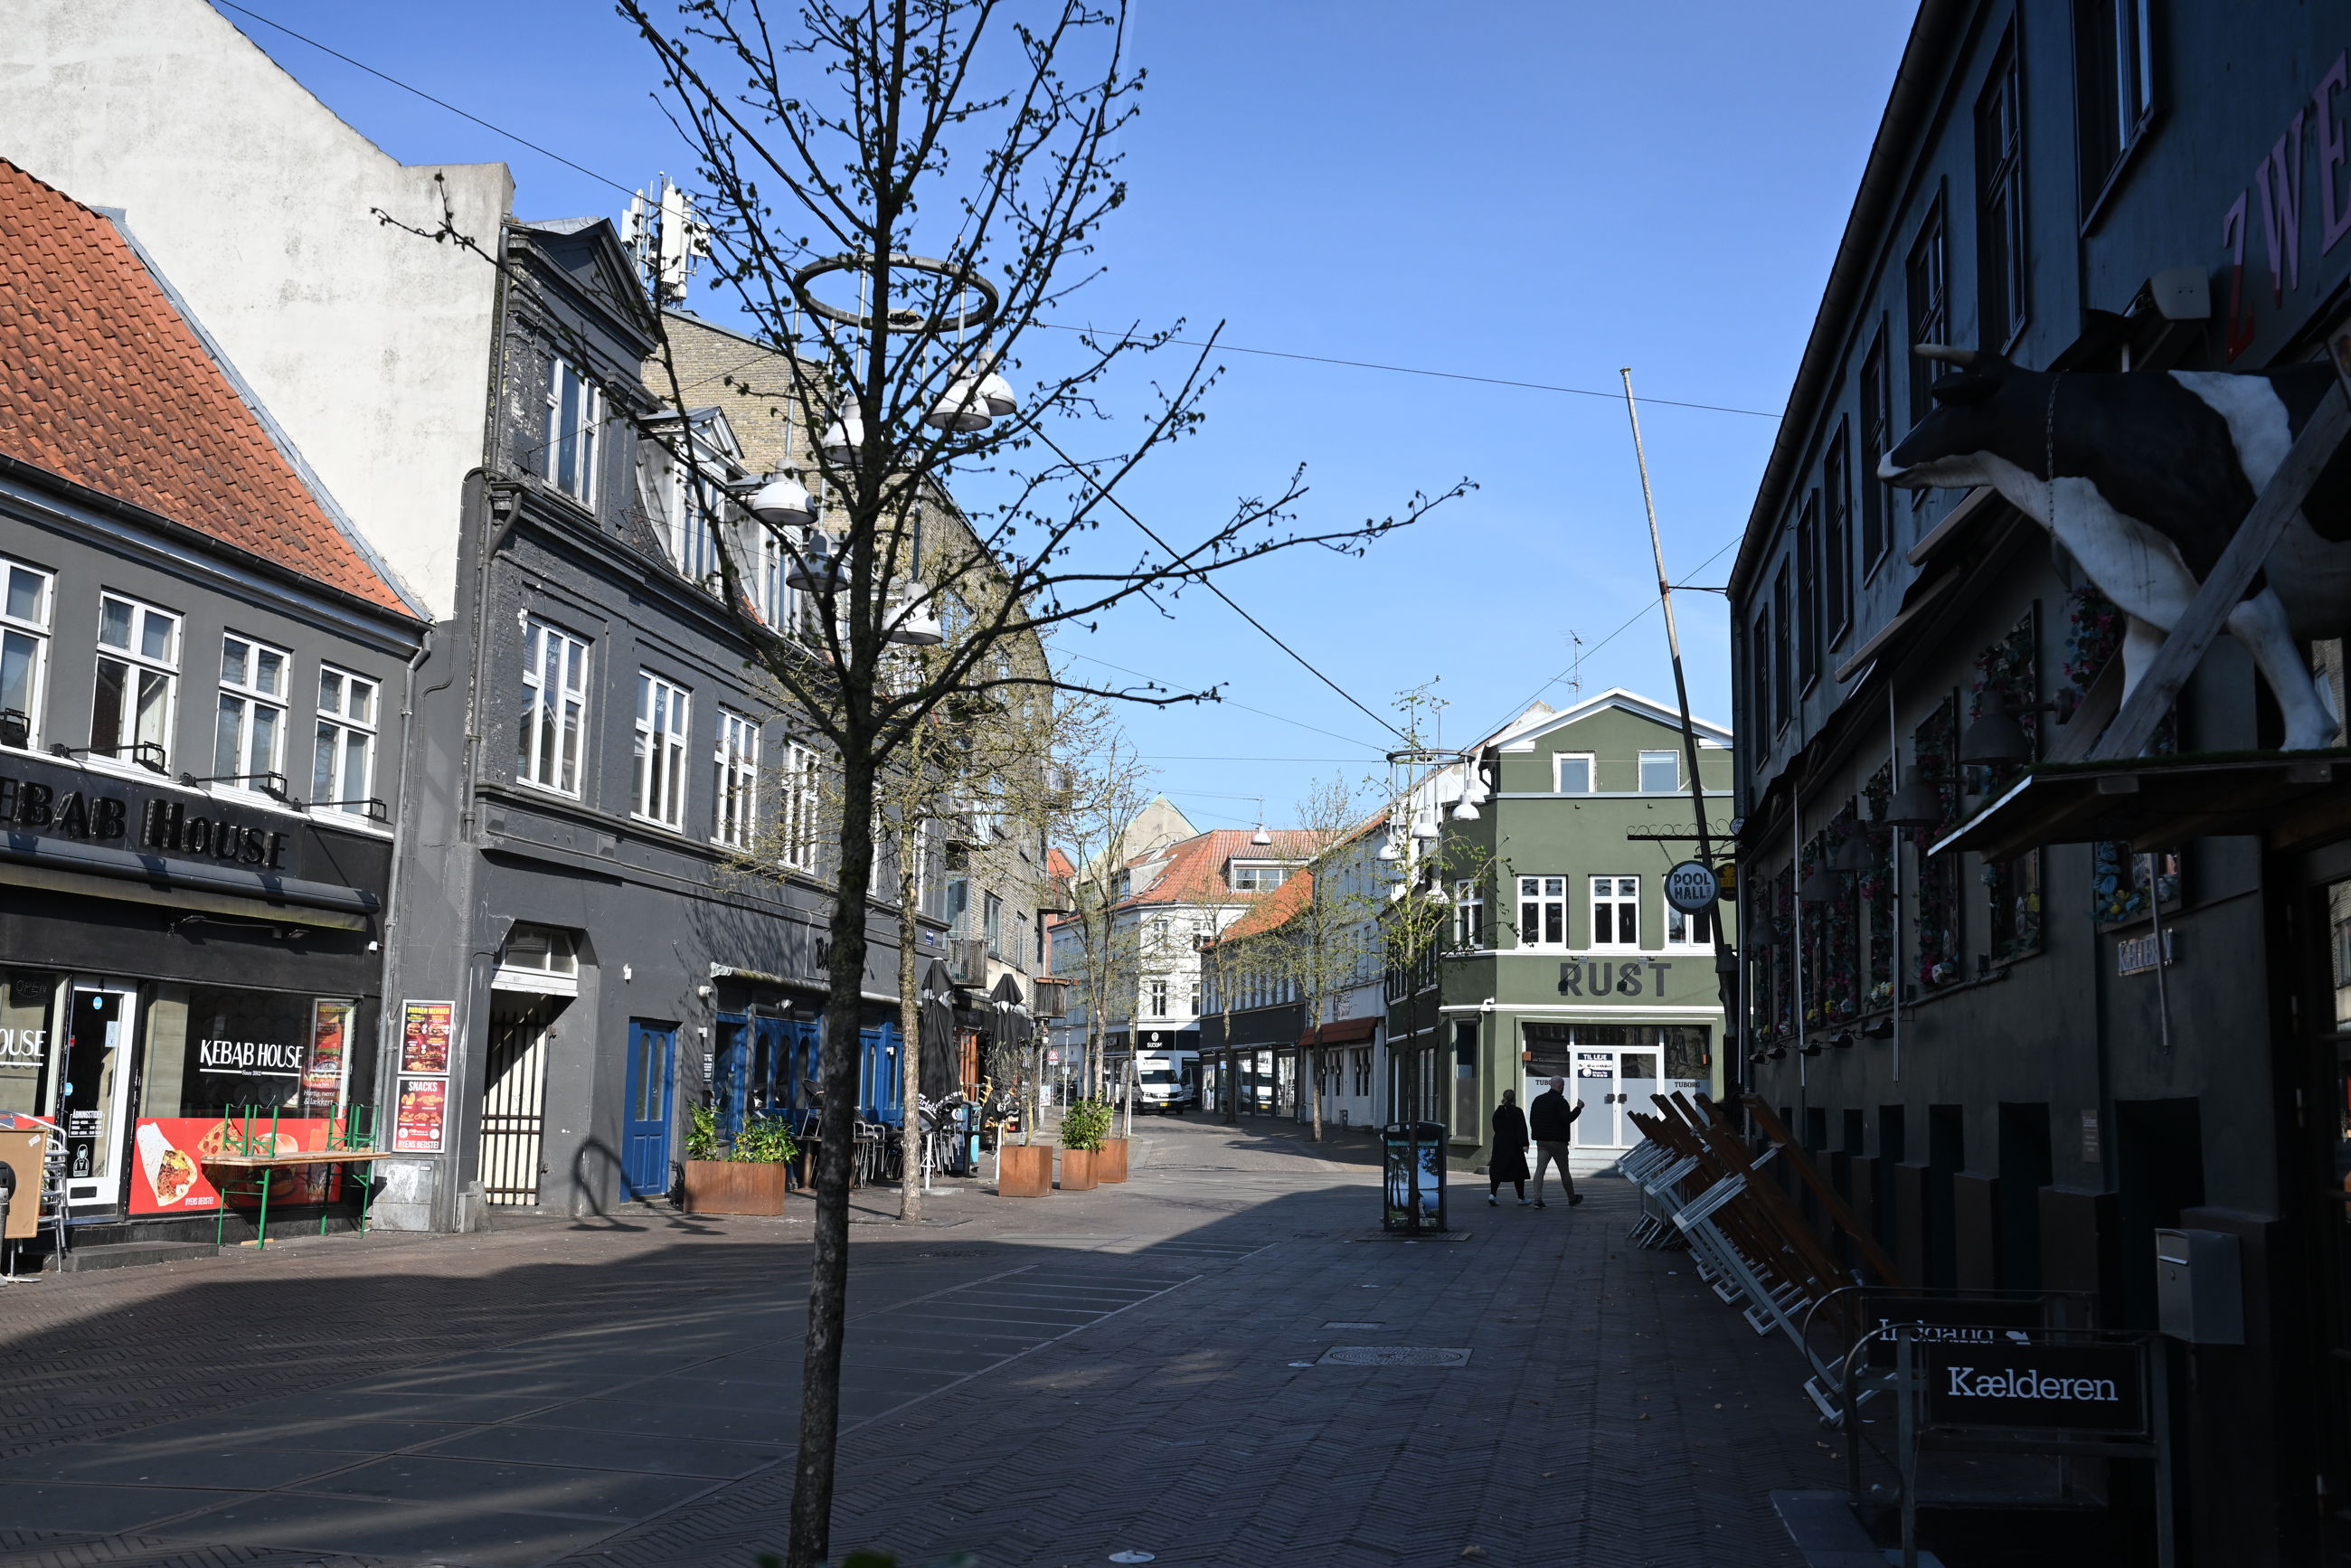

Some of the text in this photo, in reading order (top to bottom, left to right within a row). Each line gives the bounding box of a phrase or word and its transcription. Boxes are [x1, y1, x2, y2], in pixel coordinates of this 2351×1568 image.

[144, 798, 288, 870] HOUSE
[1674, 873, 1710, 885] POOL
[1675, 887, 1705, 900] HALL
[99, 978, 105, 991] 4
[1560, 963, 1672, 997] RUST
[200, 1039, 304, 1068] KEBAB HOUSE
[409, 1082, 438, 1092] SNACKS
[398, 1140, 416, 1148] BYENS
[1879, 1318, 1996, 1346] Idgang
[1948, 1366, 2119, 1402] Kælderen
